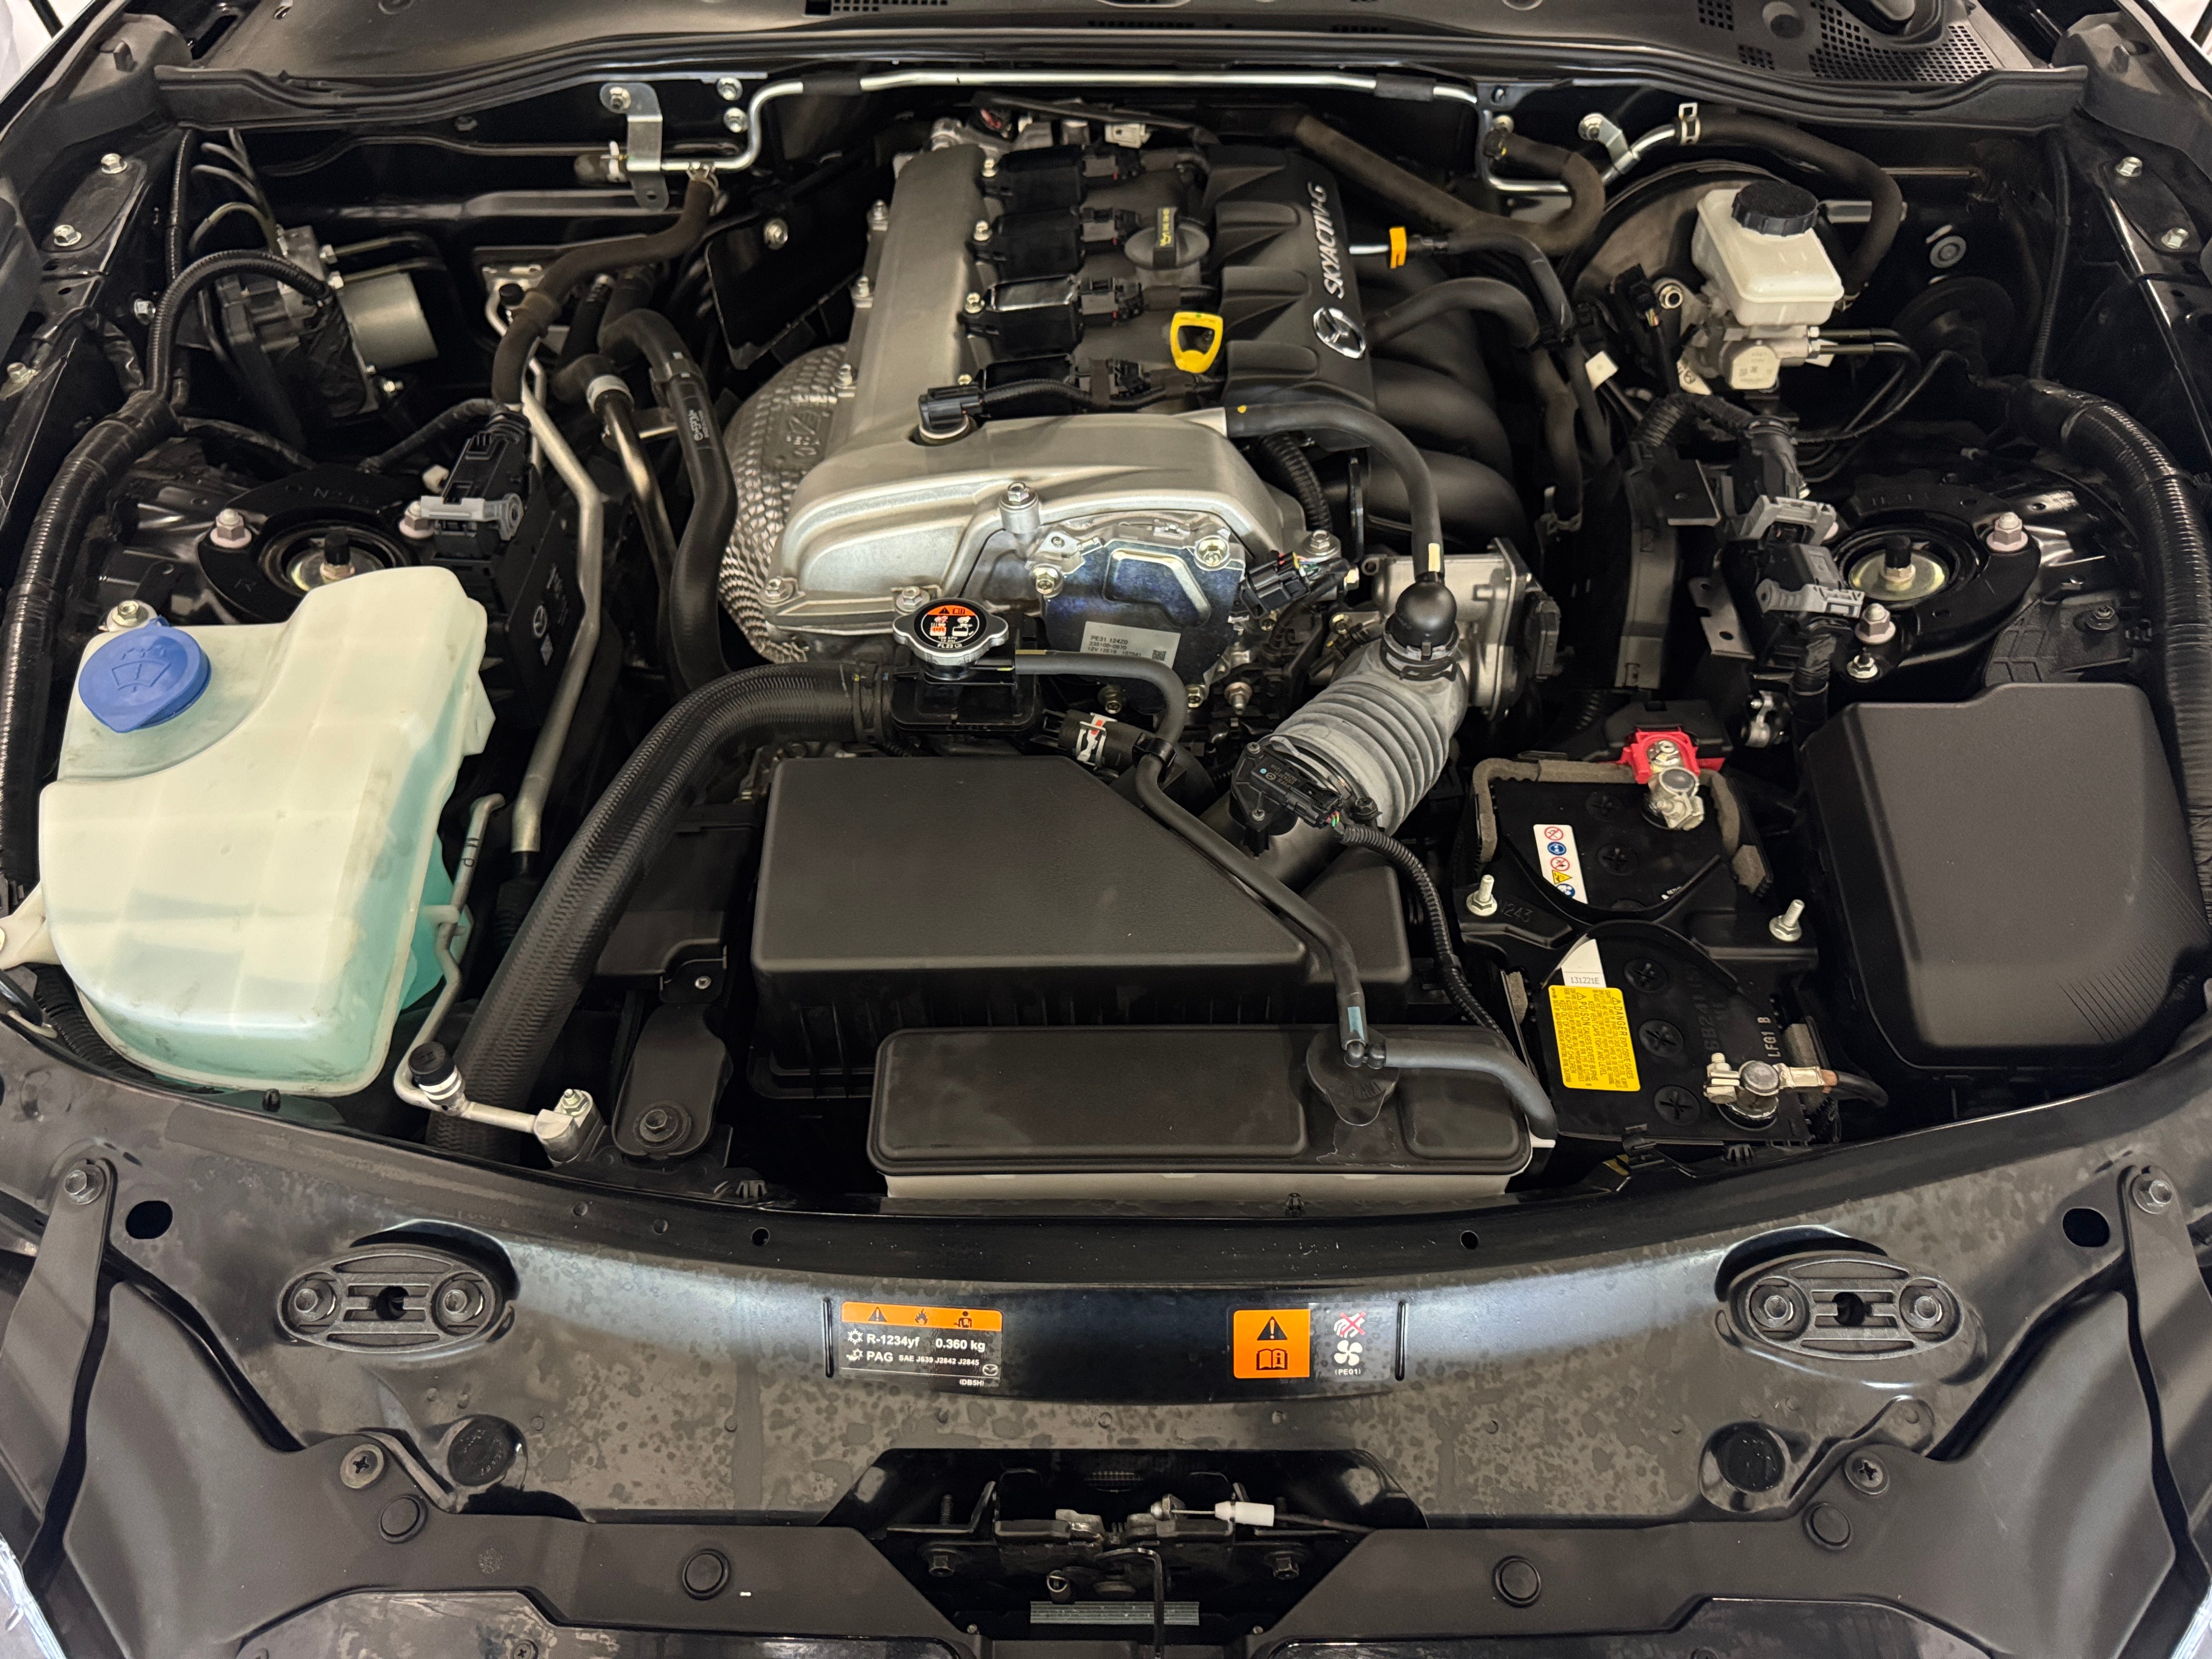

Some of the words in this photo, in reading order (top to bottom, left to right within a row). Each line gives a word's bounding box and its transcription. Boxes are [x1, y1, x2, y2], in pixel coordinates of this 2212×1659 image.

[1307, 180, 1344, 300] SKYACTIV-G
[1578, 1001, 1590, 1025] POISON
[1614, 1006, 1627, 1036] DANGER
[1583, 1027, 1591, 1045] CAUSES
[1760, 1031, 1781, 1058] LFG1
[1586, 1046, 1594, 1064] SEVERE
[1620, 1037, 1629, 1062] EXPLOSIVE
[1624, 1063, 1633, 1079] GASES
[867, 1334, 920, 1348] R-1234yf
[935, 1338, 968, 1350] 0.360
[971, 1340, 985, 1352] kg
[867, 1351, 893, 1362] PAG
